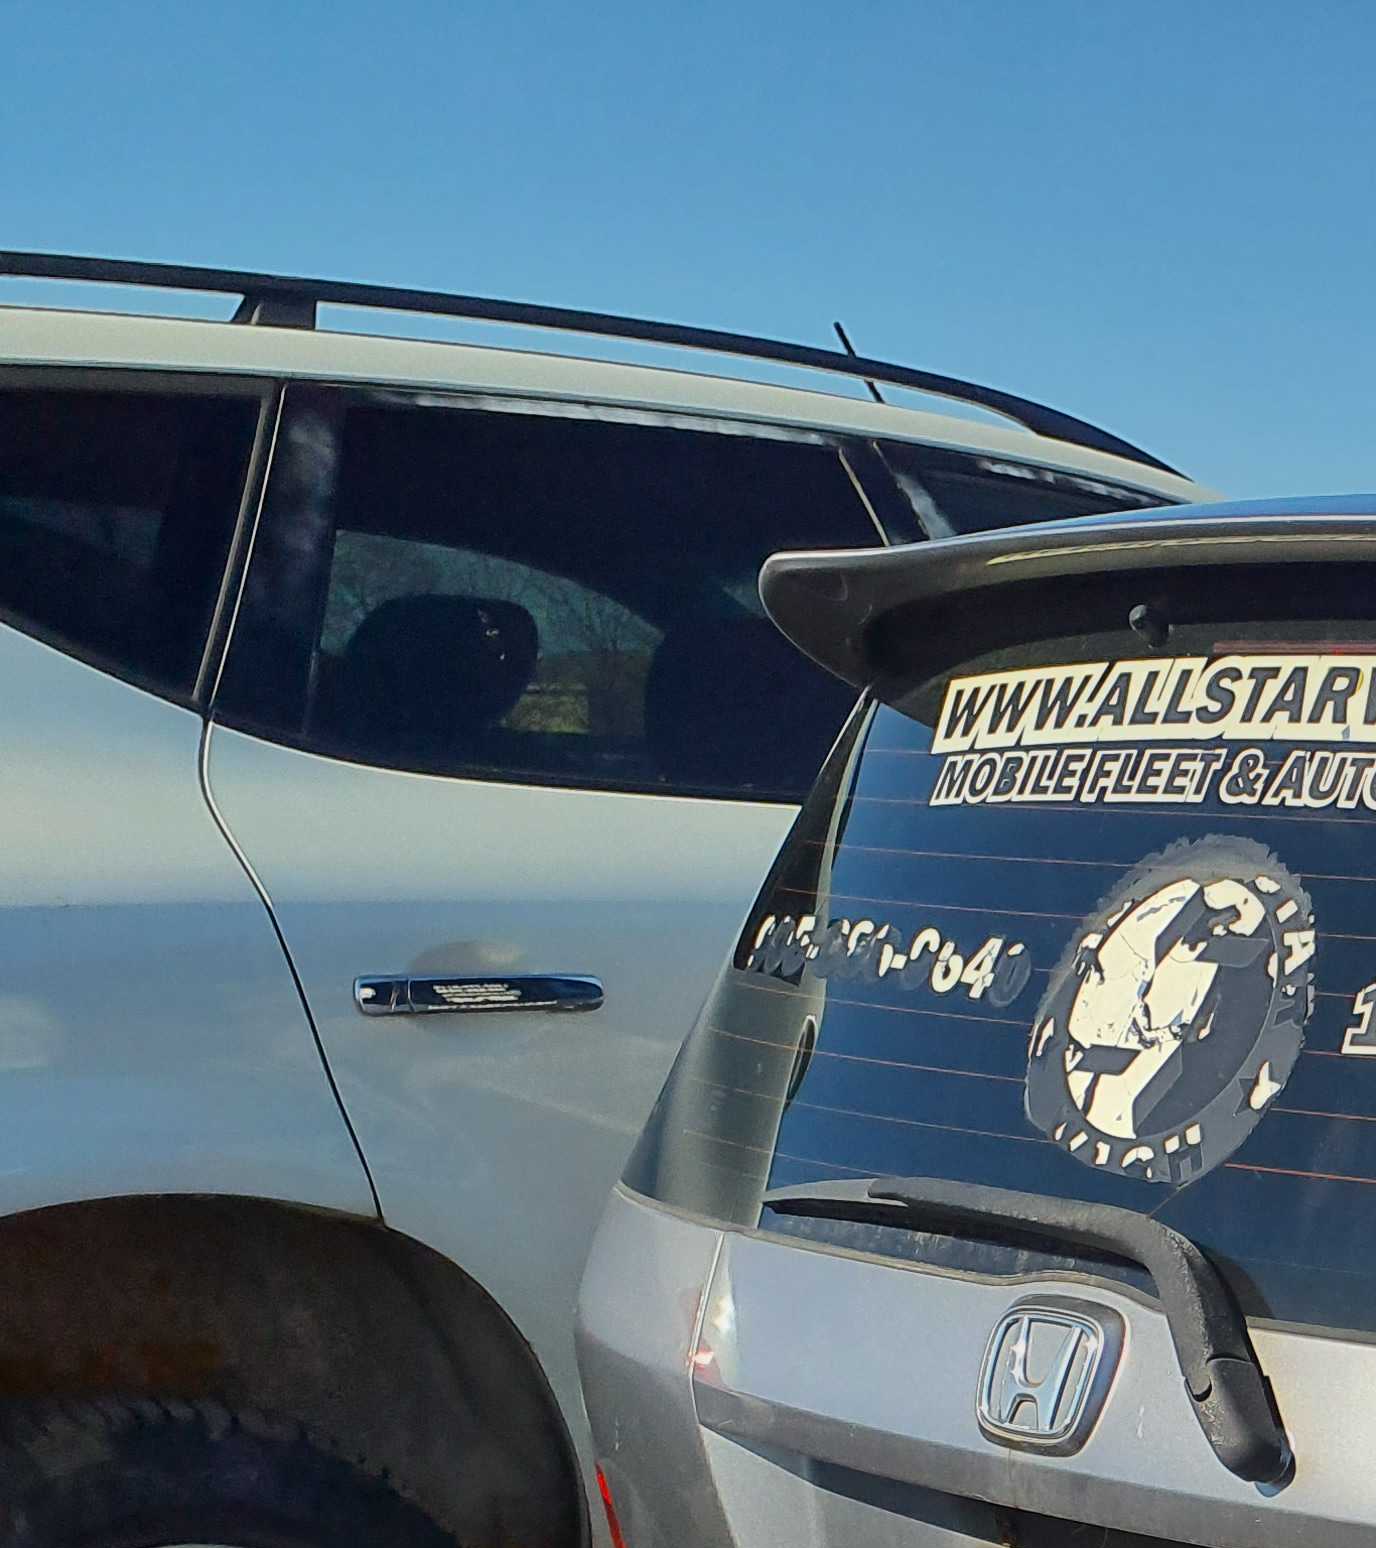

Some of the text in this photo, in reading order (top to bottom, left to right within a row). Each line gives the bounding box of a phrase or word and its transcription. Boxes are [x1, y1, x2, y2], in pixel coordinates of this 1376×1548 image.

[930, 750, 1086, 805] MOBILE
[1083, 750, 1226, 803] FLEET
[1218, 748, 1267, 804] &
